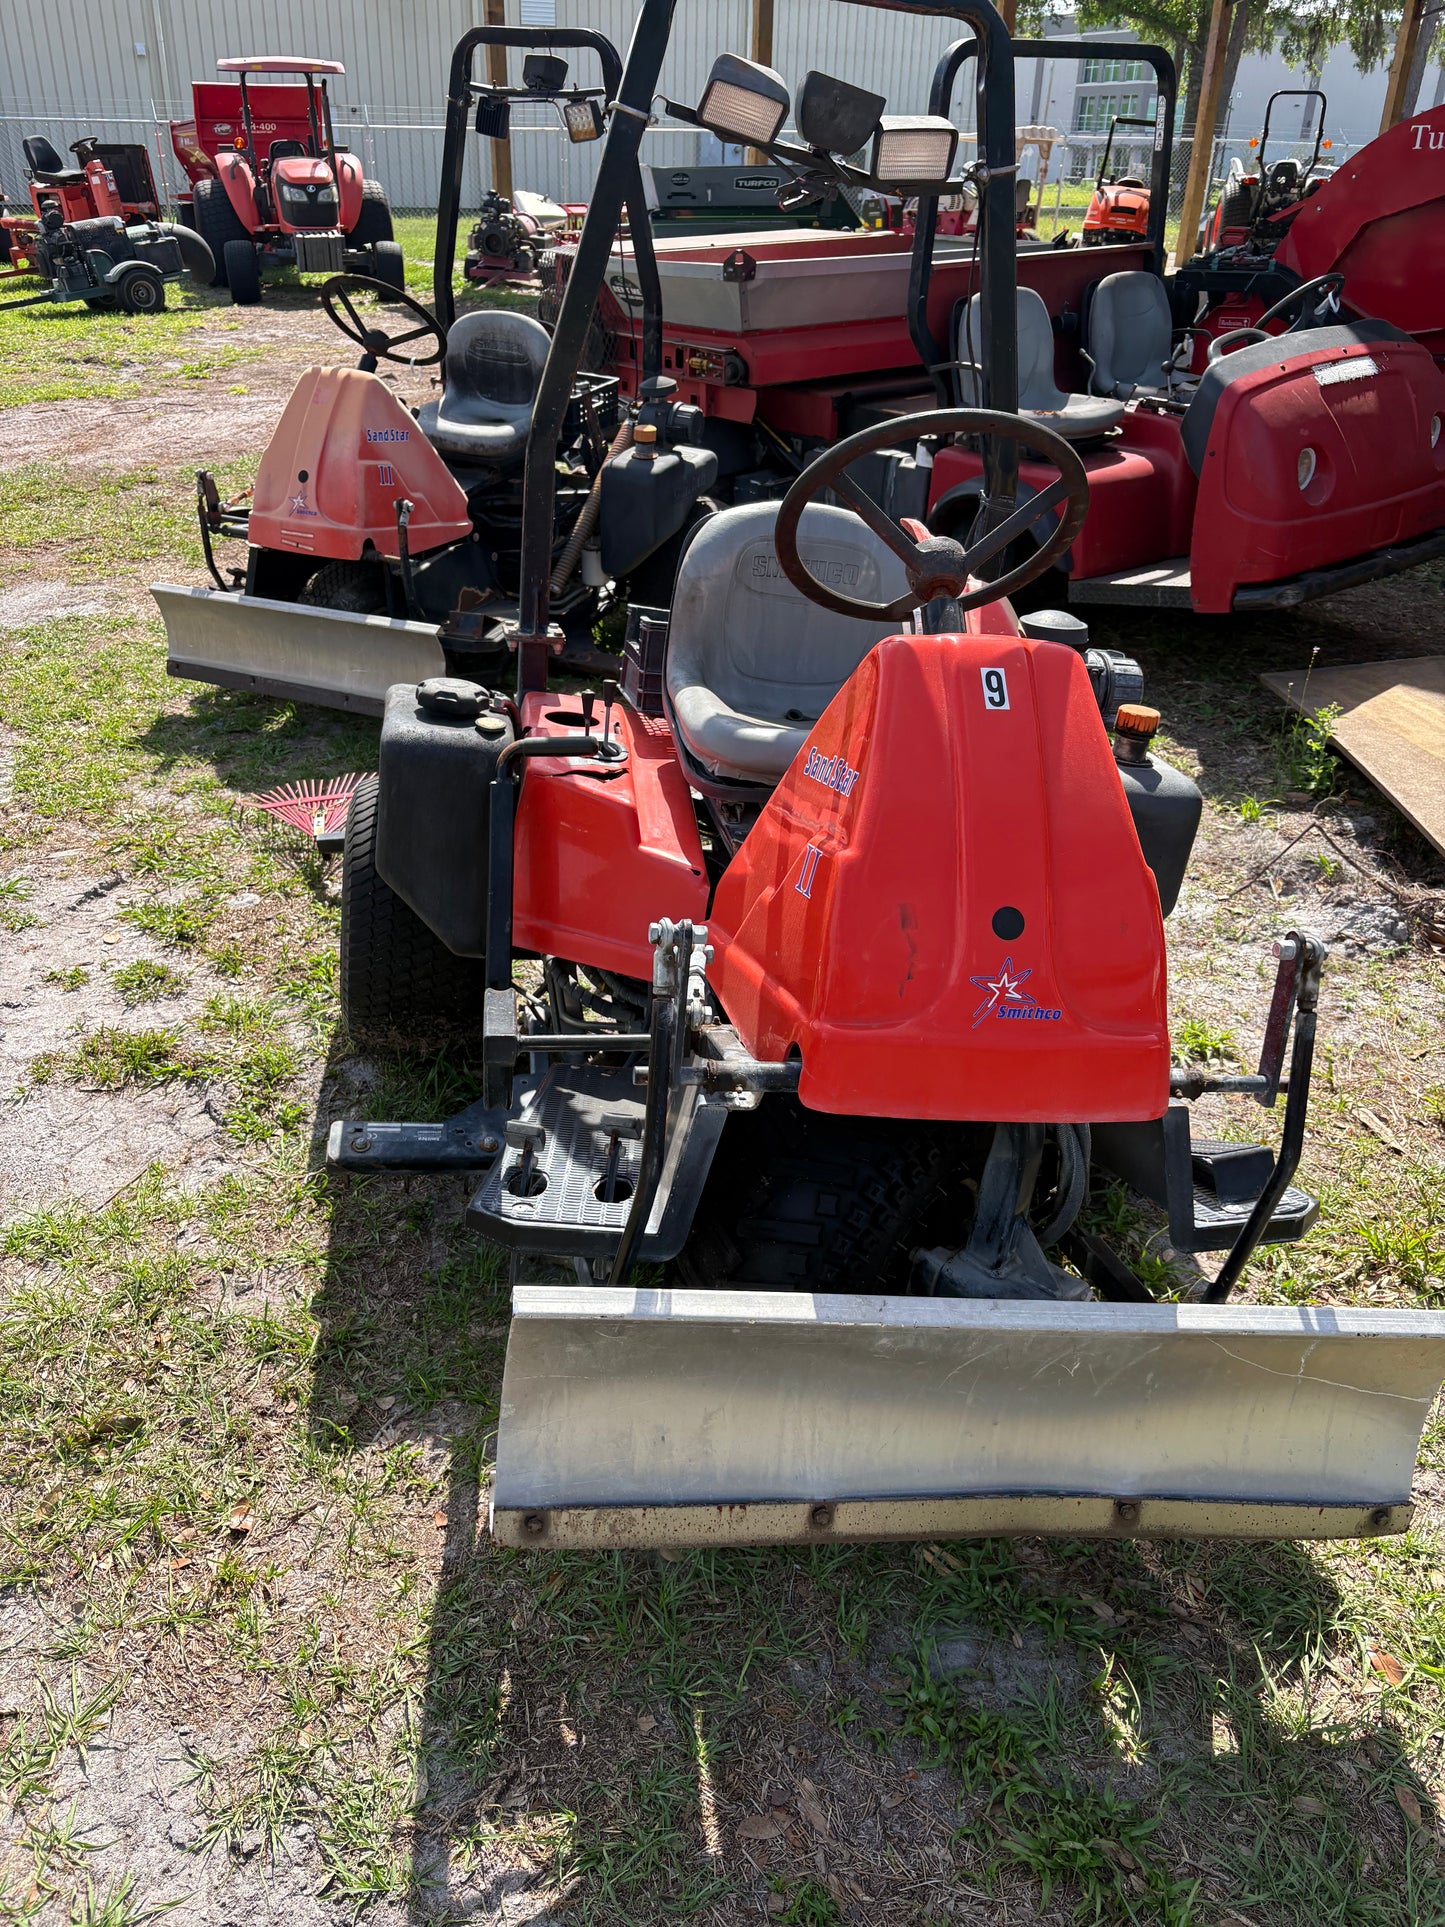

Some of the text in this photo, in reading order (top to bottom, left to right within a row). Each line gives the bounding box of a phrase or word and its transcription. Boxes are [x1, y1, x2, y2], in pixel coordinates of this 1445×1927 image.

[1410, 124, 1445, 150] Tu
[985, 670, 1006, 708] 9
[996, 1005, 1062, 1021] Smithco
